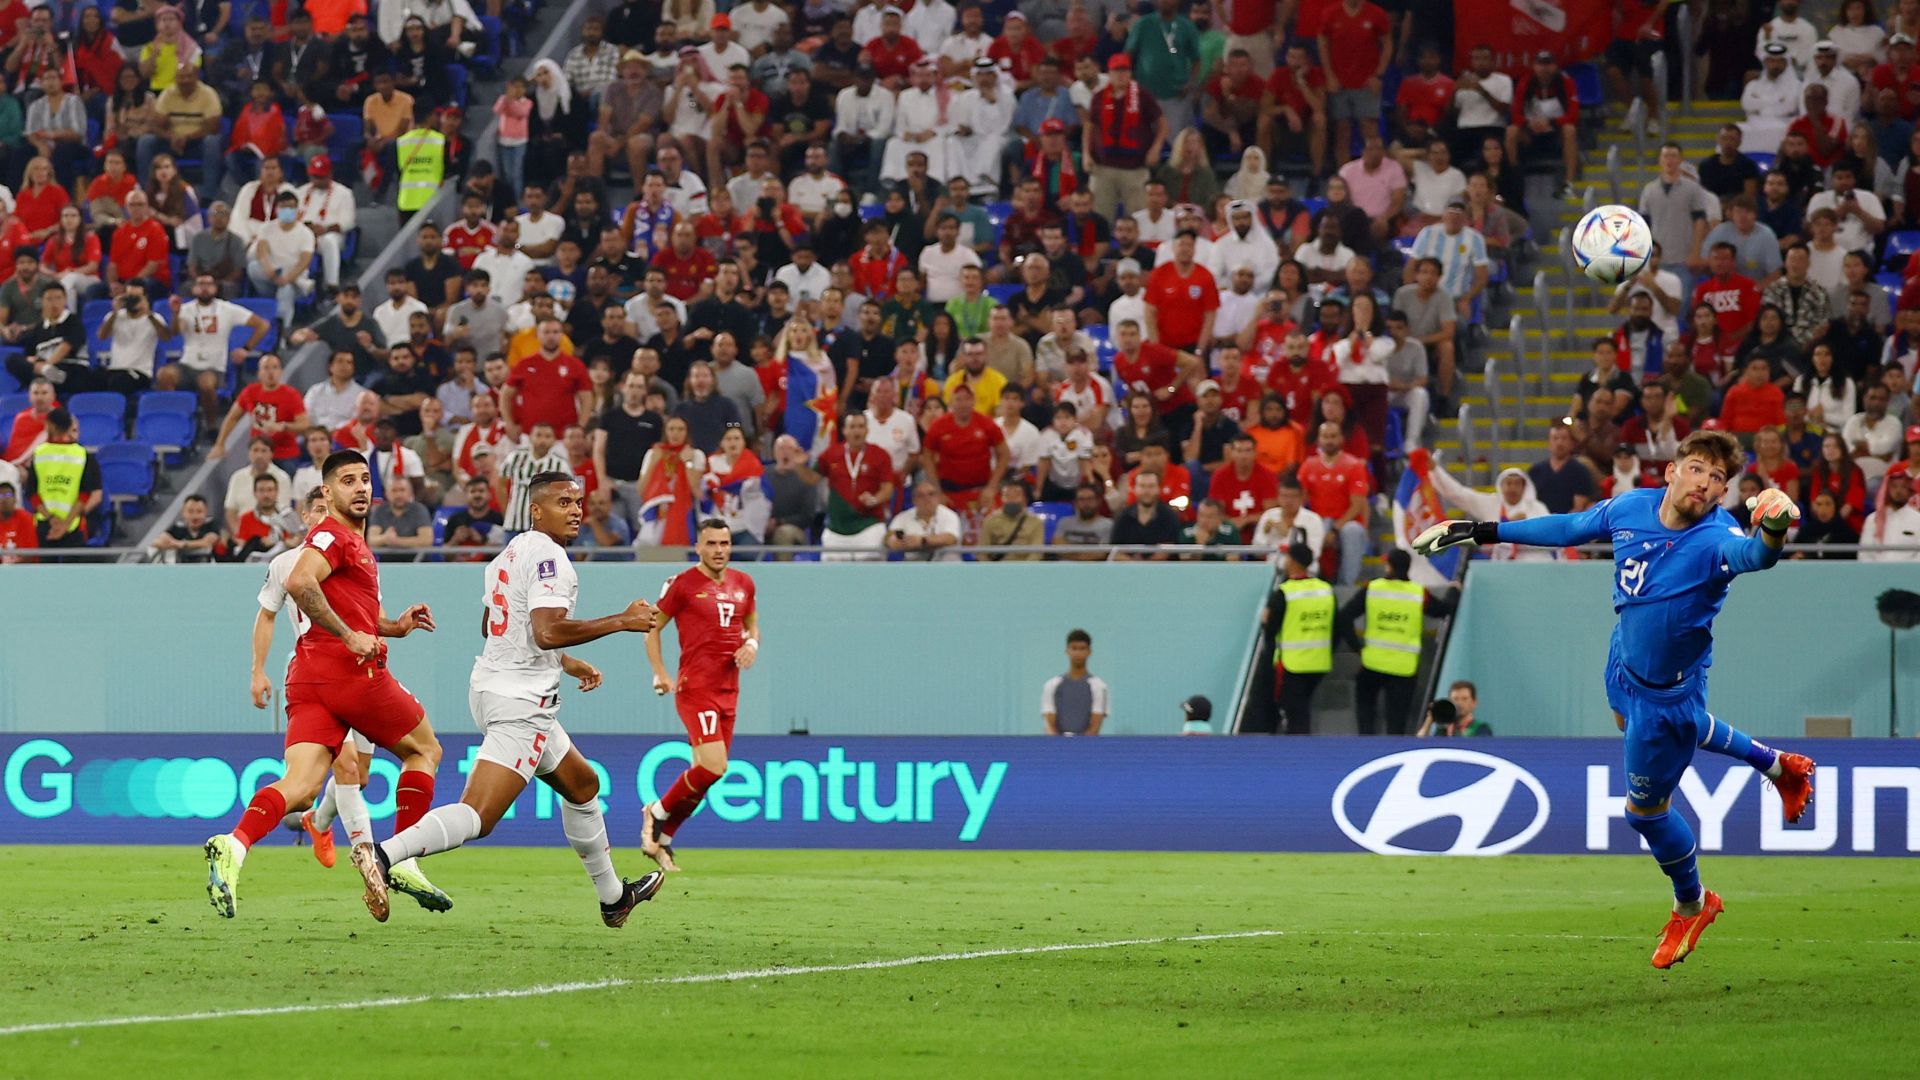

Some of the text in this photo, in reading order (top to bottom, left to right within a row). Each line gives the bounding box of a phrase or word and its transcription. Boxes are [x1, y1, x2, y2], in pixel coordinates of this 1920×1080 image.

[1620, 557, 1648, 597] 21
[490, 568, 510, 637] 5
[716, 602, 735, 628] 17
[697, 710, 718, 736] 17
[528, 732, 547, 768] 5
[637, 741, 1008, 842] Century
